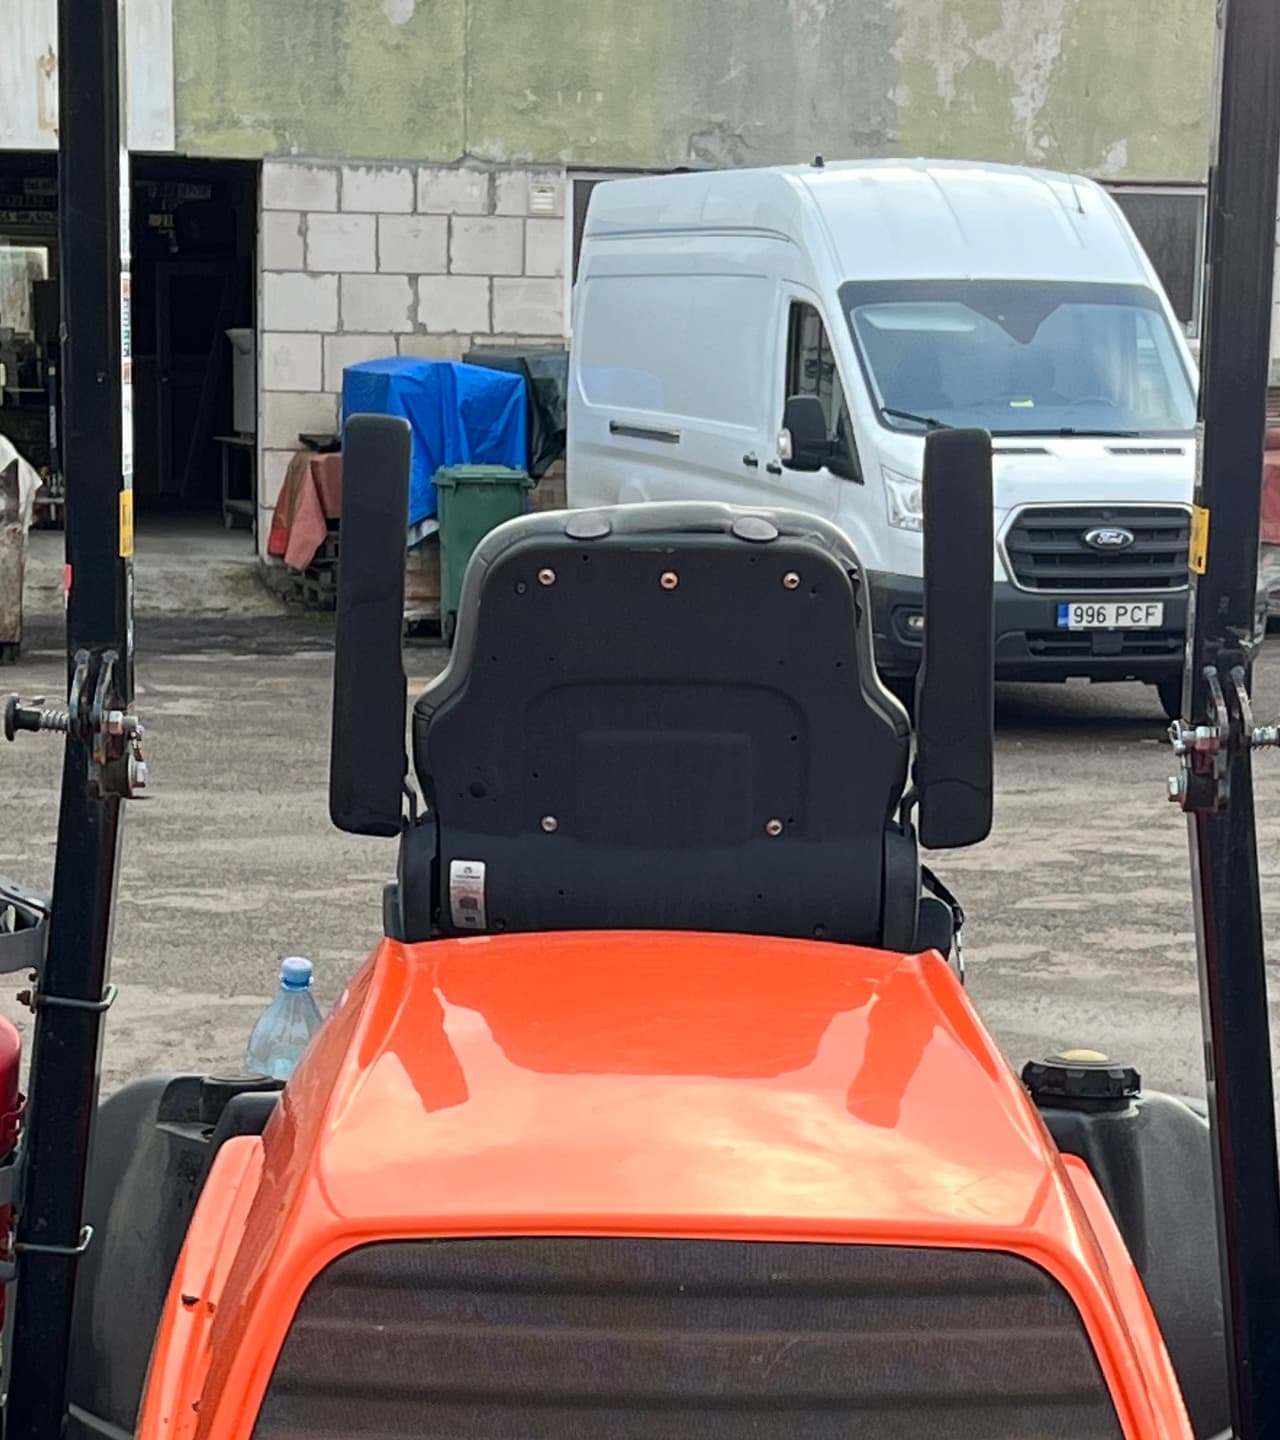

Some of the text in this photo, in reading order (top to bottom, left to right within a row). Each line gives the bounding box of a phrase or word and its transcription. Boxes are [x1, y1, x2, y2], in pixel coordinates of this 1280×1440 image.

[1096, 531, 1124, 545] Ford
[1073, 605, 1159, 624] 996 PCF
